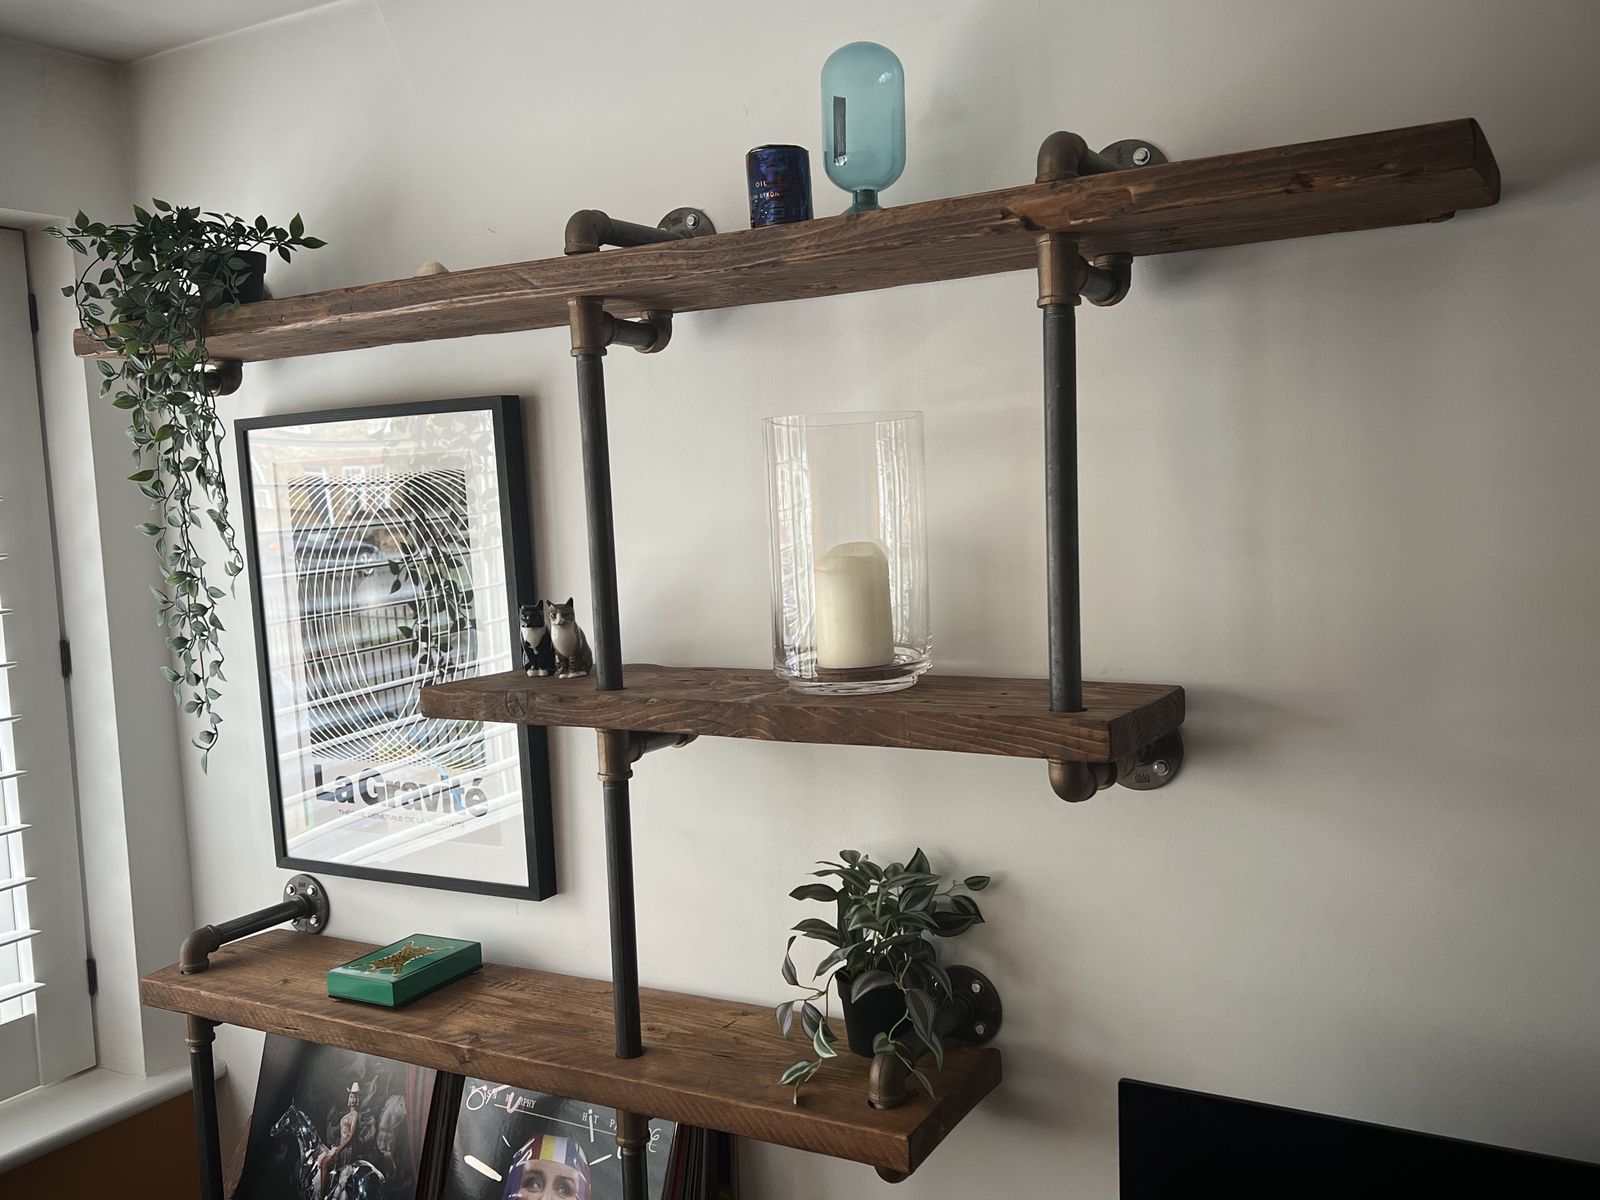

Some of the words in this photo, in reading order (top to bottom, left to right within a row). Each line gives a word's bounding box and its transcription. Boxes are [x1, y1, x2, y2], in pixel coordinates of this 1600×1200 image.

[754, 180, 768, 188] OIL
[759, 191, 780, 199] DIXON
[313, 764, 355, 804] La
[358, 767, 489, 818] Gravité
